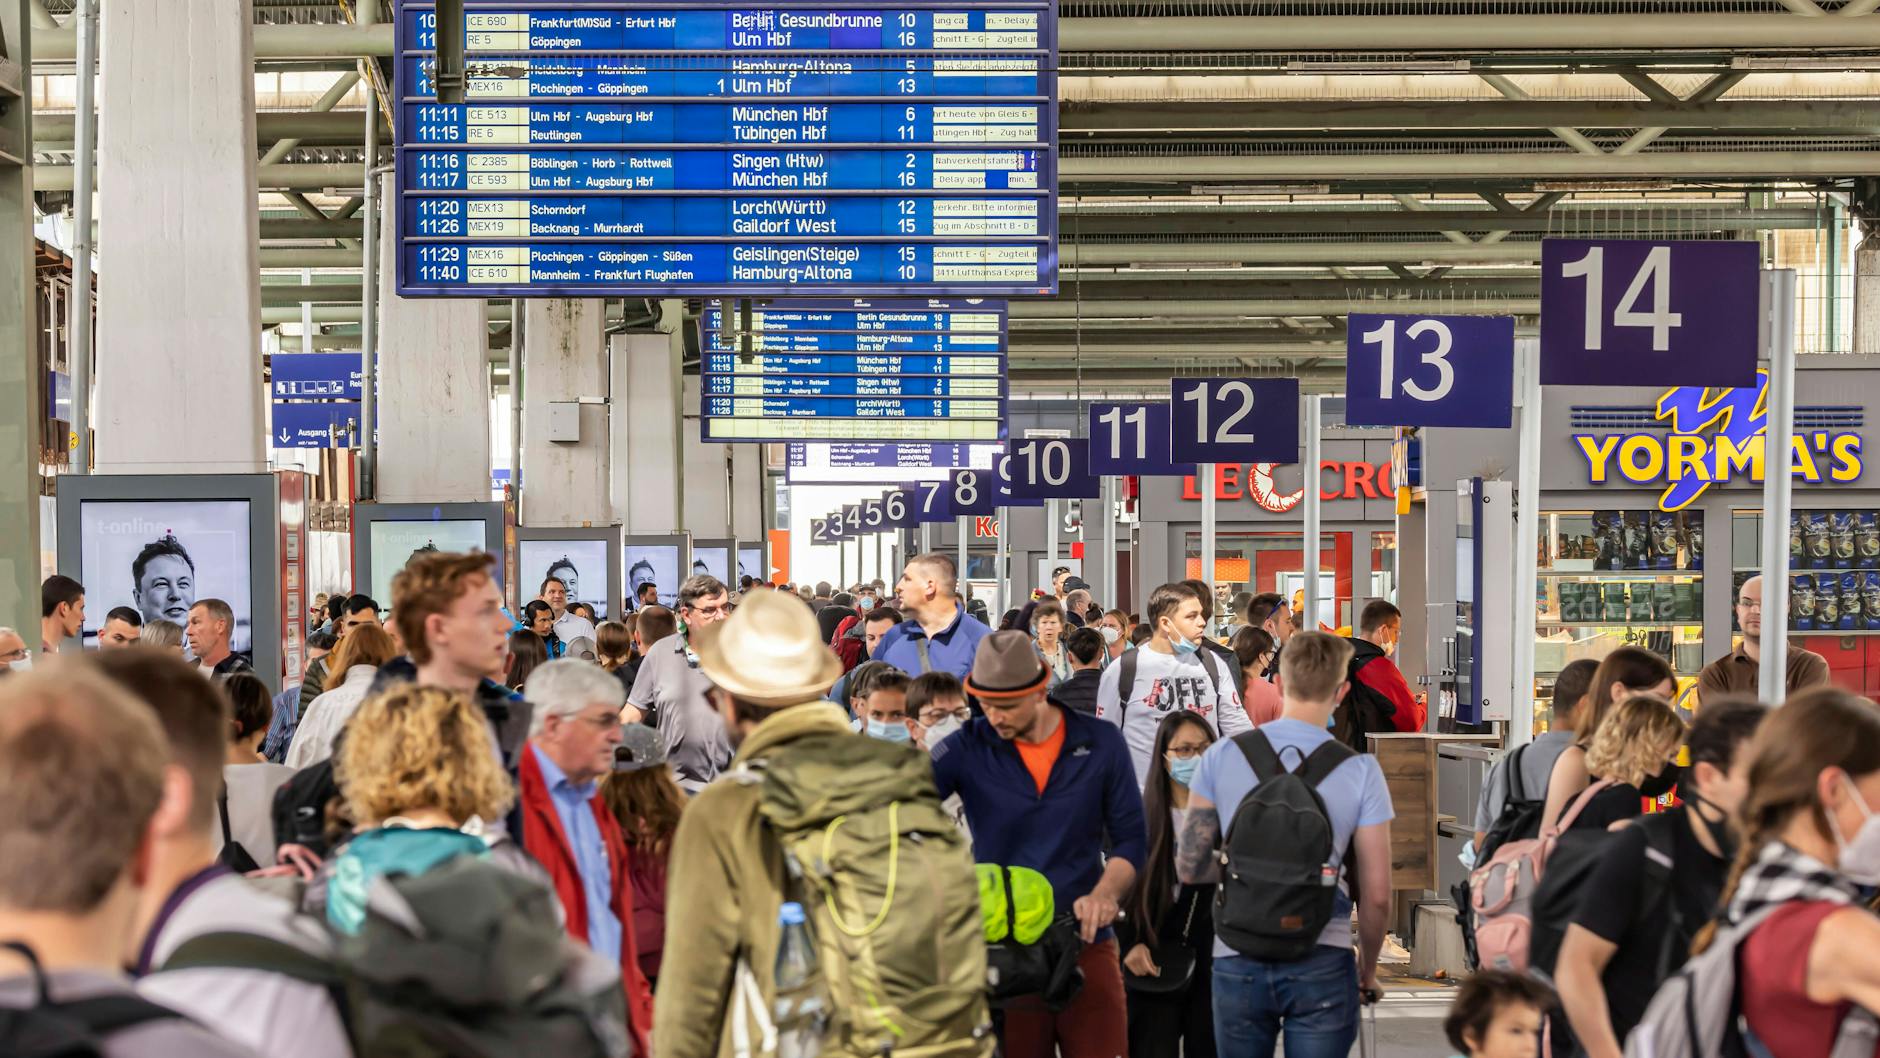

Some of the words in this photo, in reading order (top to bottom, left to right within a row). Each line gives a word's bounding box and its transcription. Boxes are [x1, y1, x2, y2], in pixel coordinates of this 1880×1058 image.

[468, 16, 483, 26] ICE
[487, 16, 507, 26] 690
[530, 17, 612, 28] Frankfurt(M)Süd
[625, 17, 655, 28] Erfurt
[658, 17, 677, 28] Hbf
[779, 13, 883, 28] Gesundbrunne
[898, 13, 916, 28] 10
[468, 34, 480, 45] RE
[484, 34, 491, 45] 5
[530, 36, 582, 48] Göppingen
[732, 31, 762, 46] Ulm
[767, 31, 792, 46] Hbf
[898, 31, 916, 46] 16
[732, 59, 853, 78] Hamburg-Altona
[905, 60, 916, 75] 5
[468, 81, 503, 91] MEX16
[530, 83, 584, 95] Plochingen
[597, 83, 649, 95] Göppingen
[732, 78, 762, 93] Ulm
[767, 78, 792, 93] Hbf
[898, 78, 916, 93] 13
[419, 107, 458, 122] 11:11
[468, 109, 483, 120] ICE
[487, 109, 507, 120] 513
[530, 111, 551, 122] Ulm
[553, 111, 571, 122] Hbf
[585, 112, 633, 124] Augsburg
[635, 111, 654, 122] Hbf
[732, 106, 798, 122] München
[803, 106, 828, 122] Hbf
[905, 106, 916, 122] 6
[419, 125, 459, 141] 11:15
[468, 128, 483, 138] IRE
[487, 128, 494, 138] 6
[530, 129, 582, 142] Reutlingen
[732, 125, 797, 143] Tübingen
[802, 125, 827, 140] Hbf
[898, 125, 915, 140] 11
[419, 153, 459, 169] 11:16
[468, 156, 478, 166] IC
[482, 156, 508, 166] 2385
[530, 156, 579, 170] Böblingen
[592, 157, 616, 169] Horb
[629, 157, 673, 169] Rottweil
[732, 153, 781, 172] Singen
[785, 153, 828, 171] (Htw)
[905, 153, 916, 169] 2
[419, 172, 459, 187] 11:17
[468, 175, 484, 185] ICE
[487, 175, 507, 185] 593
[530, 174, 551, 187] Ulm
[553, 174, 571, 187] Hbf
[585, 176, 633, 189] Augsburg
[635, 175, 654, 187] Hbf
[732, 171, 798, 187] München
[803, 171, 828, 187] Hbf
[898, 171, 916, 187] 16
[419, 200, 459, 215] 11:20
[468, 203, 504, 213] MEX13
[530, 203, 586, 216] Schorndorf
[732, 200, 826, 216] Lorch(Württ)
[898, 200, 916, 215] 12
[419, 218, 460, 234] 11:26
[468, 221, 504, 231] MEX19
[530, 221, 580, 235] Backnang
[594, 222, 644, 233] Murrhardt
[732, 218, 790, 234] Gaildorf
[795, 218, 837, 234] West
[898, 218, 916, 233] 15
[420, 247, 460, 262] 11:29
[468, 249, 504, 260] MEX16
[530, 250, 585, 264] Plochingen
[597, 251, 649, 264] Göppingen
[662, 250, 693, 262] Süßen
[732, 246, 860, 265] Geislingen(Steige)
[898, 246, 916, 261] 15
[420, 265, 460, 280] 11:40
[468, 268, 484, 278] ICE
[488, 268, 508, 278] 610
[530, 269, 581, 281] Mannheim
[594, 269, 642, 280] Frankfurt
[645, 269, 694, 282] Flughafen
[732, 265, 853, 283] Hamburg-Altona
[898, 265, 916, 280] 10
[1004, 268, 1037, 278] Expres
[1562, 246, 1682, 351] 14
[933, 313, 943, 322] 10
[933, 343, 943, 352] 13
[1362, 319, 1454, 401] 13
[933, 365, 942, 374] 11
[933, 400, 942, 408] 12
[1183, 381, 1255, 444] 12
[297, 428, 328, 438] Ausgang
[1099, 407, 1146, 459] 11
[1018, 440, 1071, 486] 10
[919, 481, 940, 513] 7
[954, 470, 979, 506] 8
[865, 499, 883, 526] 5
[887, 491, 906, 521] 6
[846, 505, 861, 529] 4
[813, 520, 828, 541] 2
